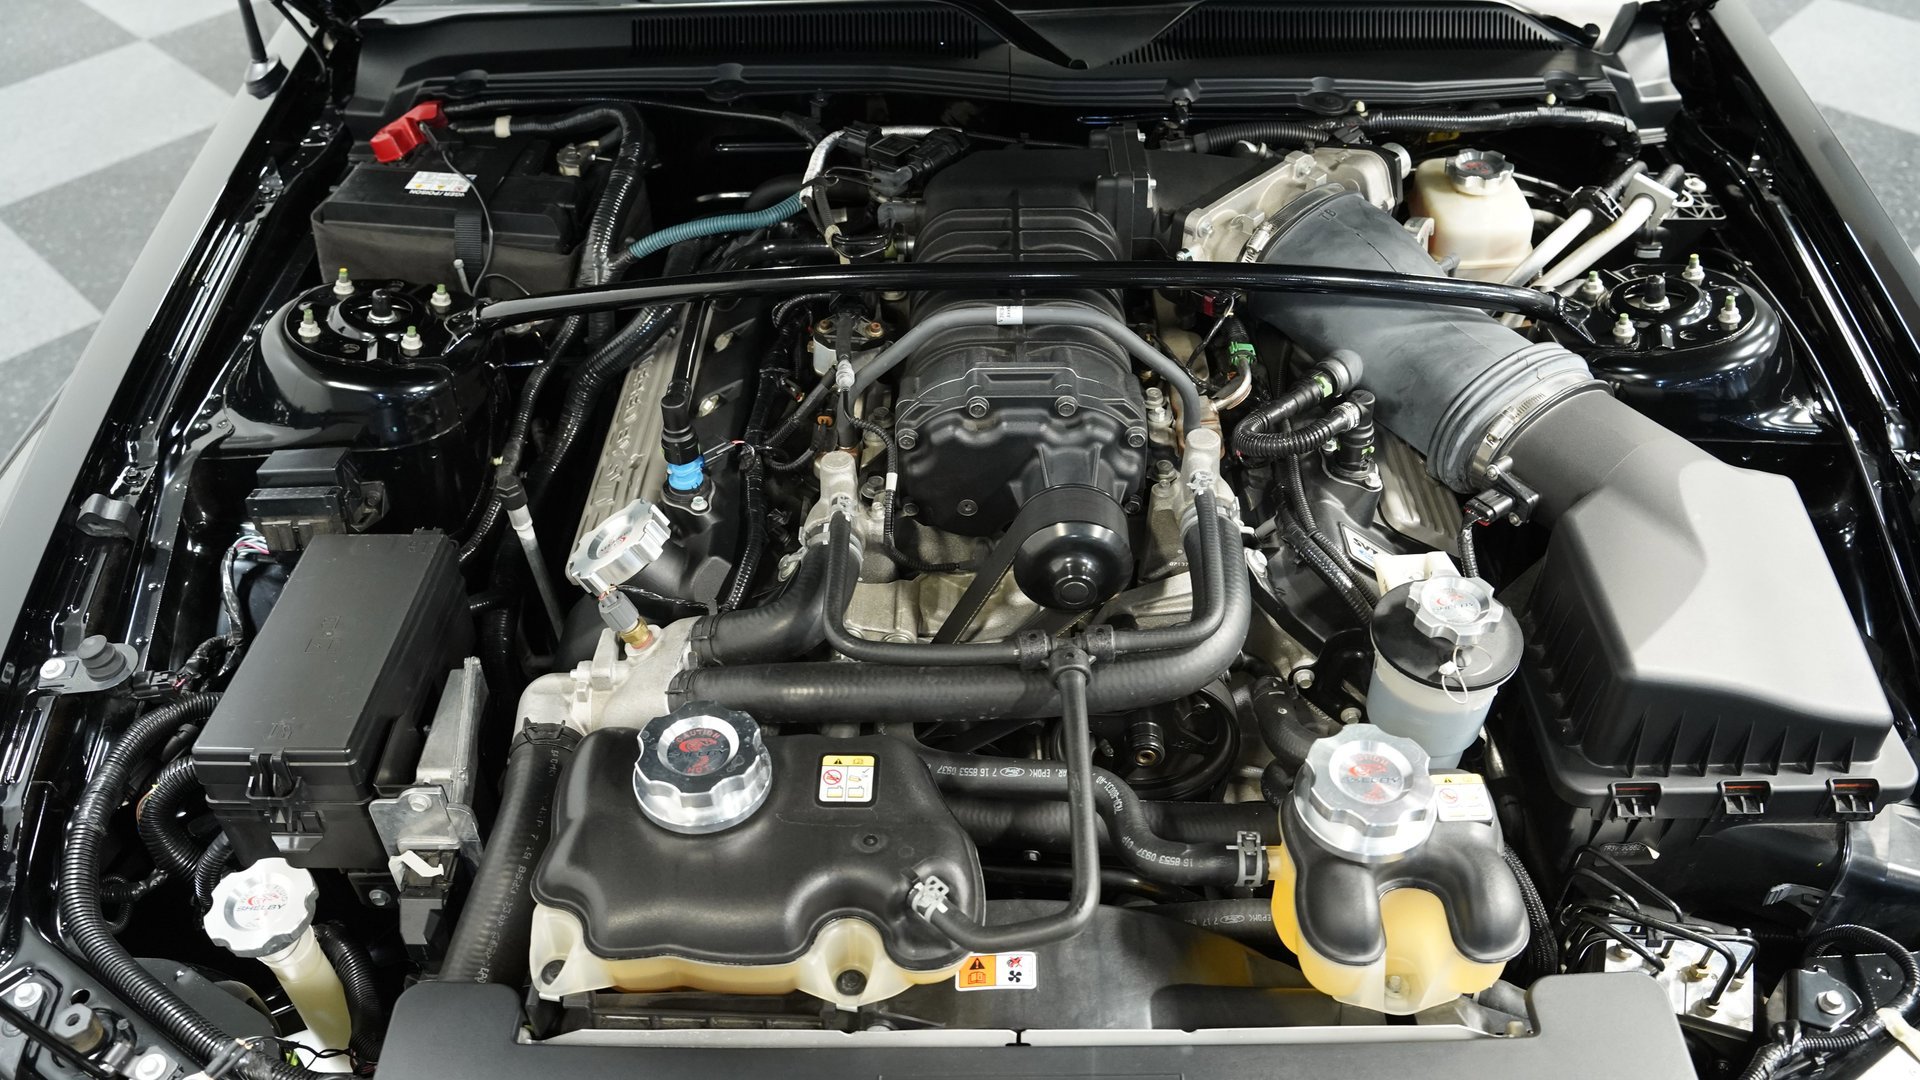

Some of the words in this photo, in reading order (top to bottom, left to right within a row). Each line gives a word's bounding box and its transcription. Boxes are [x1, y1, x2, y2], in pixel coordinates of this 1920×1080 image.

[675, 729, 721, 743] CAUTION
[1135, 847, 1157, 861] 0937
[1158, 855, 1181, 866] 8553
